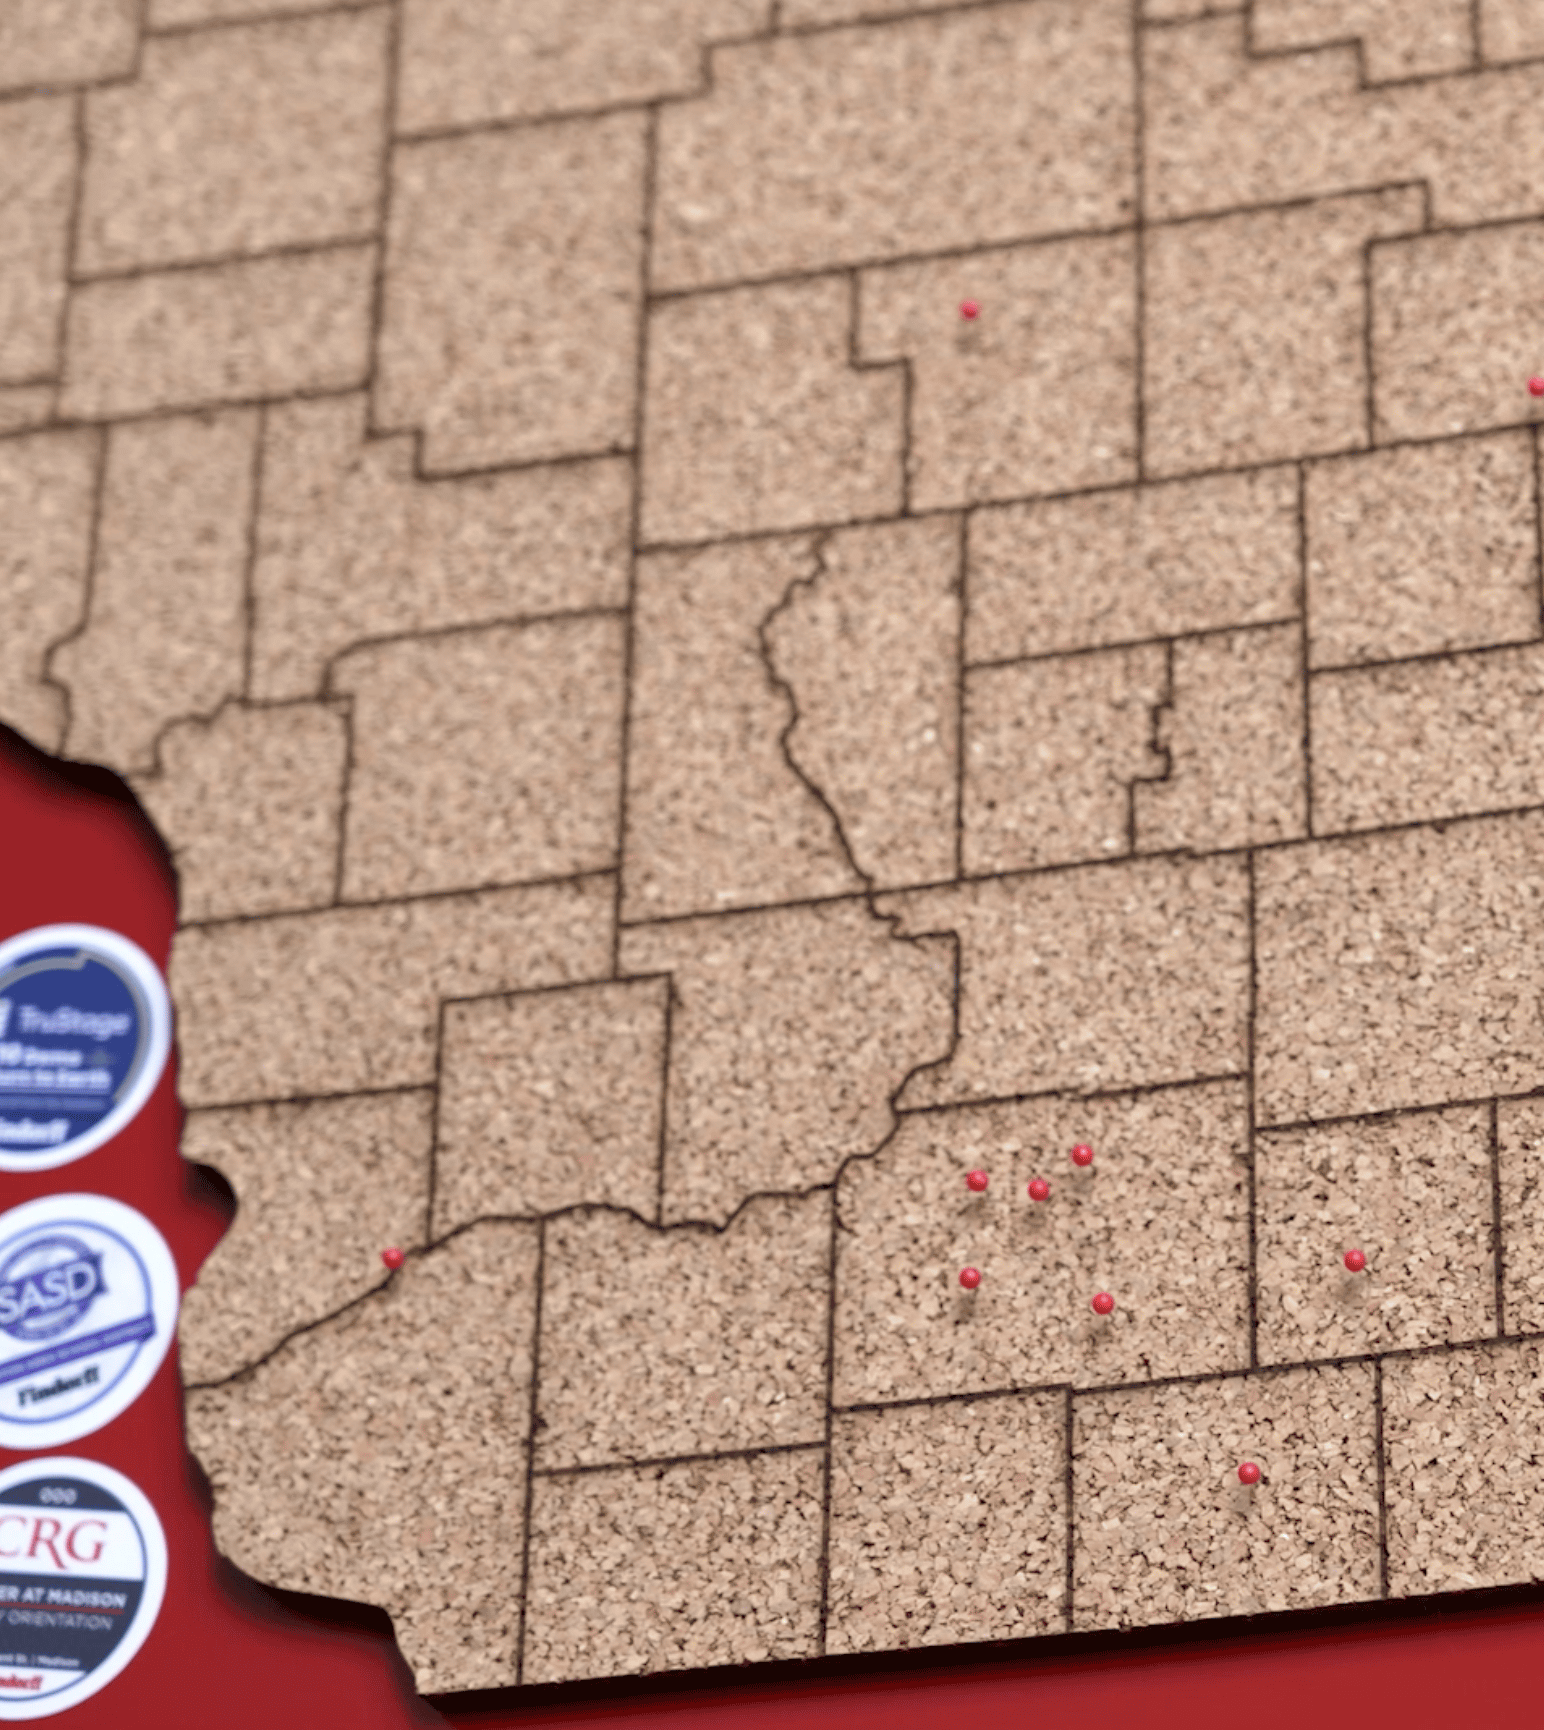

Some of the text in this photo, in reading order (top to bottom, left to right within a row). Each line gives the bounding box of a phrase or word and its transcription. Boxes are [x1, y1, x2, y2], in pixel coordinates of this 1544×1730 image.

[0, 1261, 98, 1324] SASD
[17, 1366, 100, 1408] Findorff
[22, 1587, 127, 1609] AT MADISON
